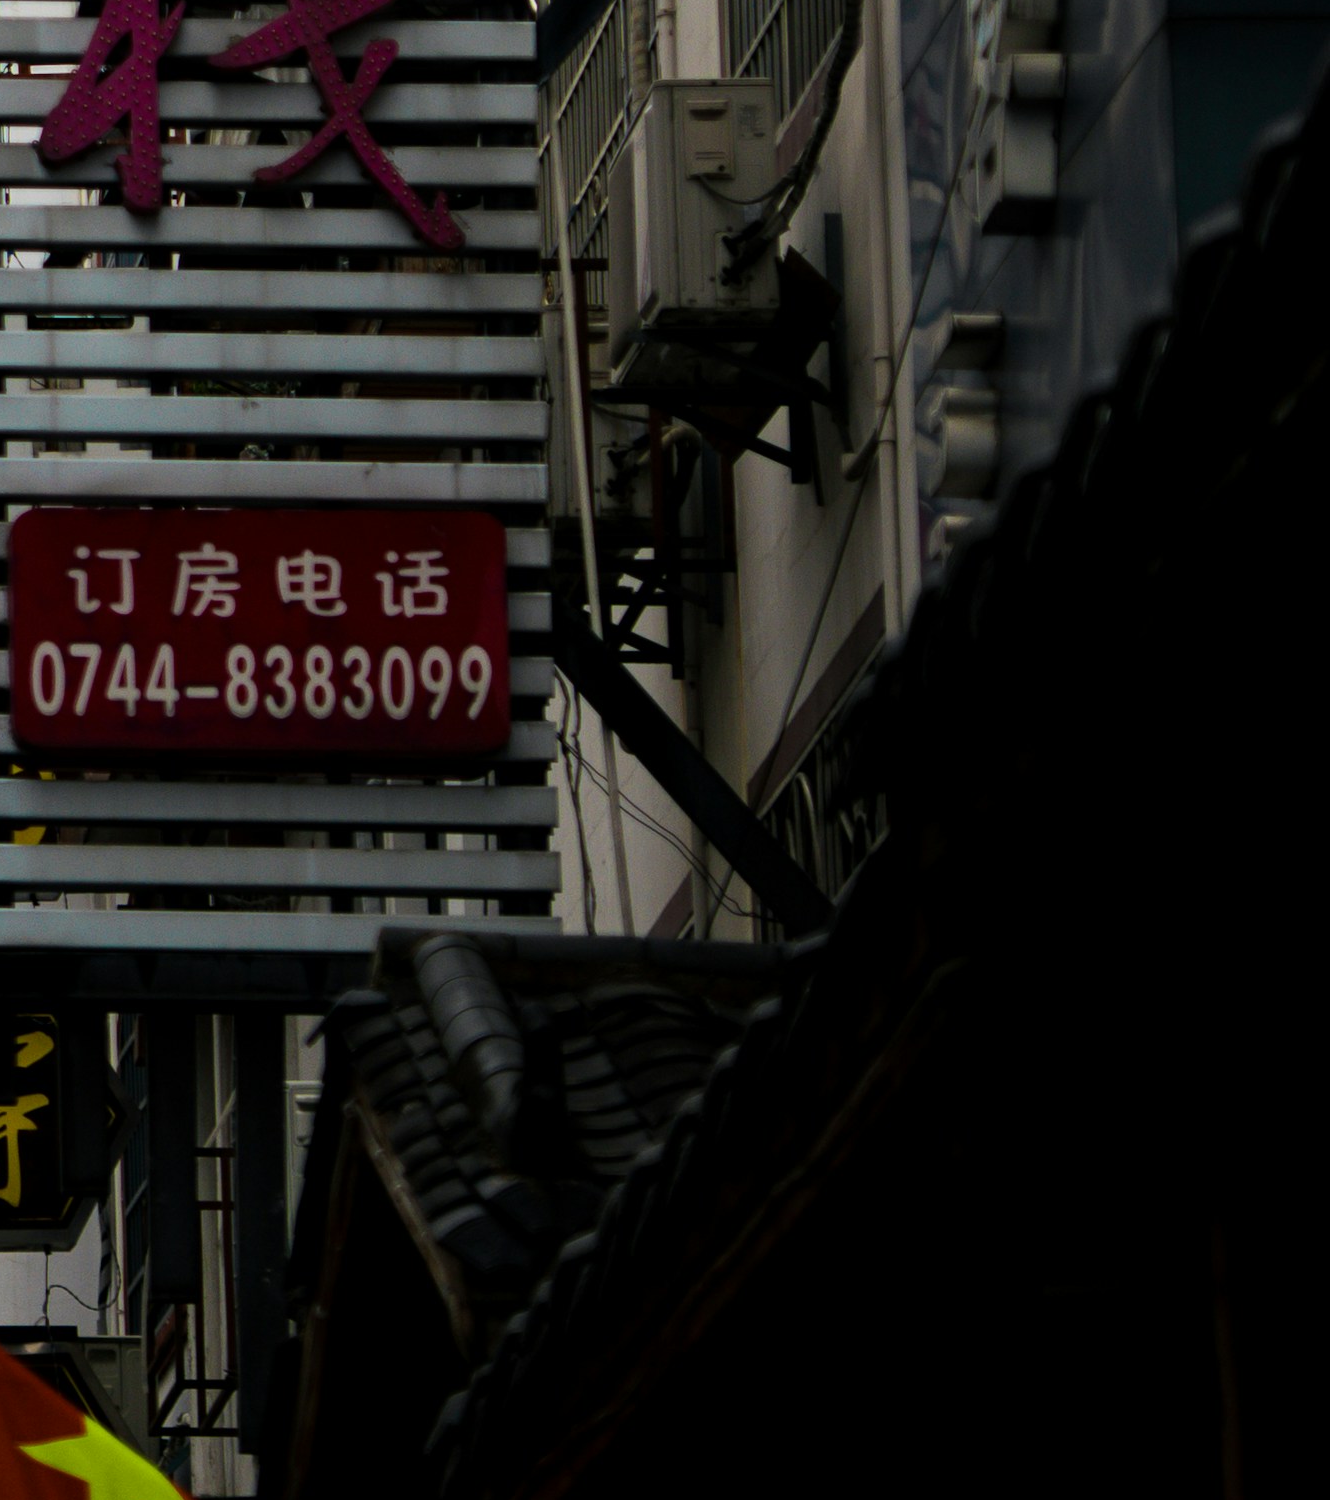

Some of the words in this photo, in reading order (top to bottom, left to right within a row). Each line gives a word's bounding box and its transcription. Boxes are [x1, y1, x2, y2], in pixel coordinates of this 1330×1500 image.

[66, 543, 450, 618] 订房电话
[30, 641, 492, 720] 0744-8383099
